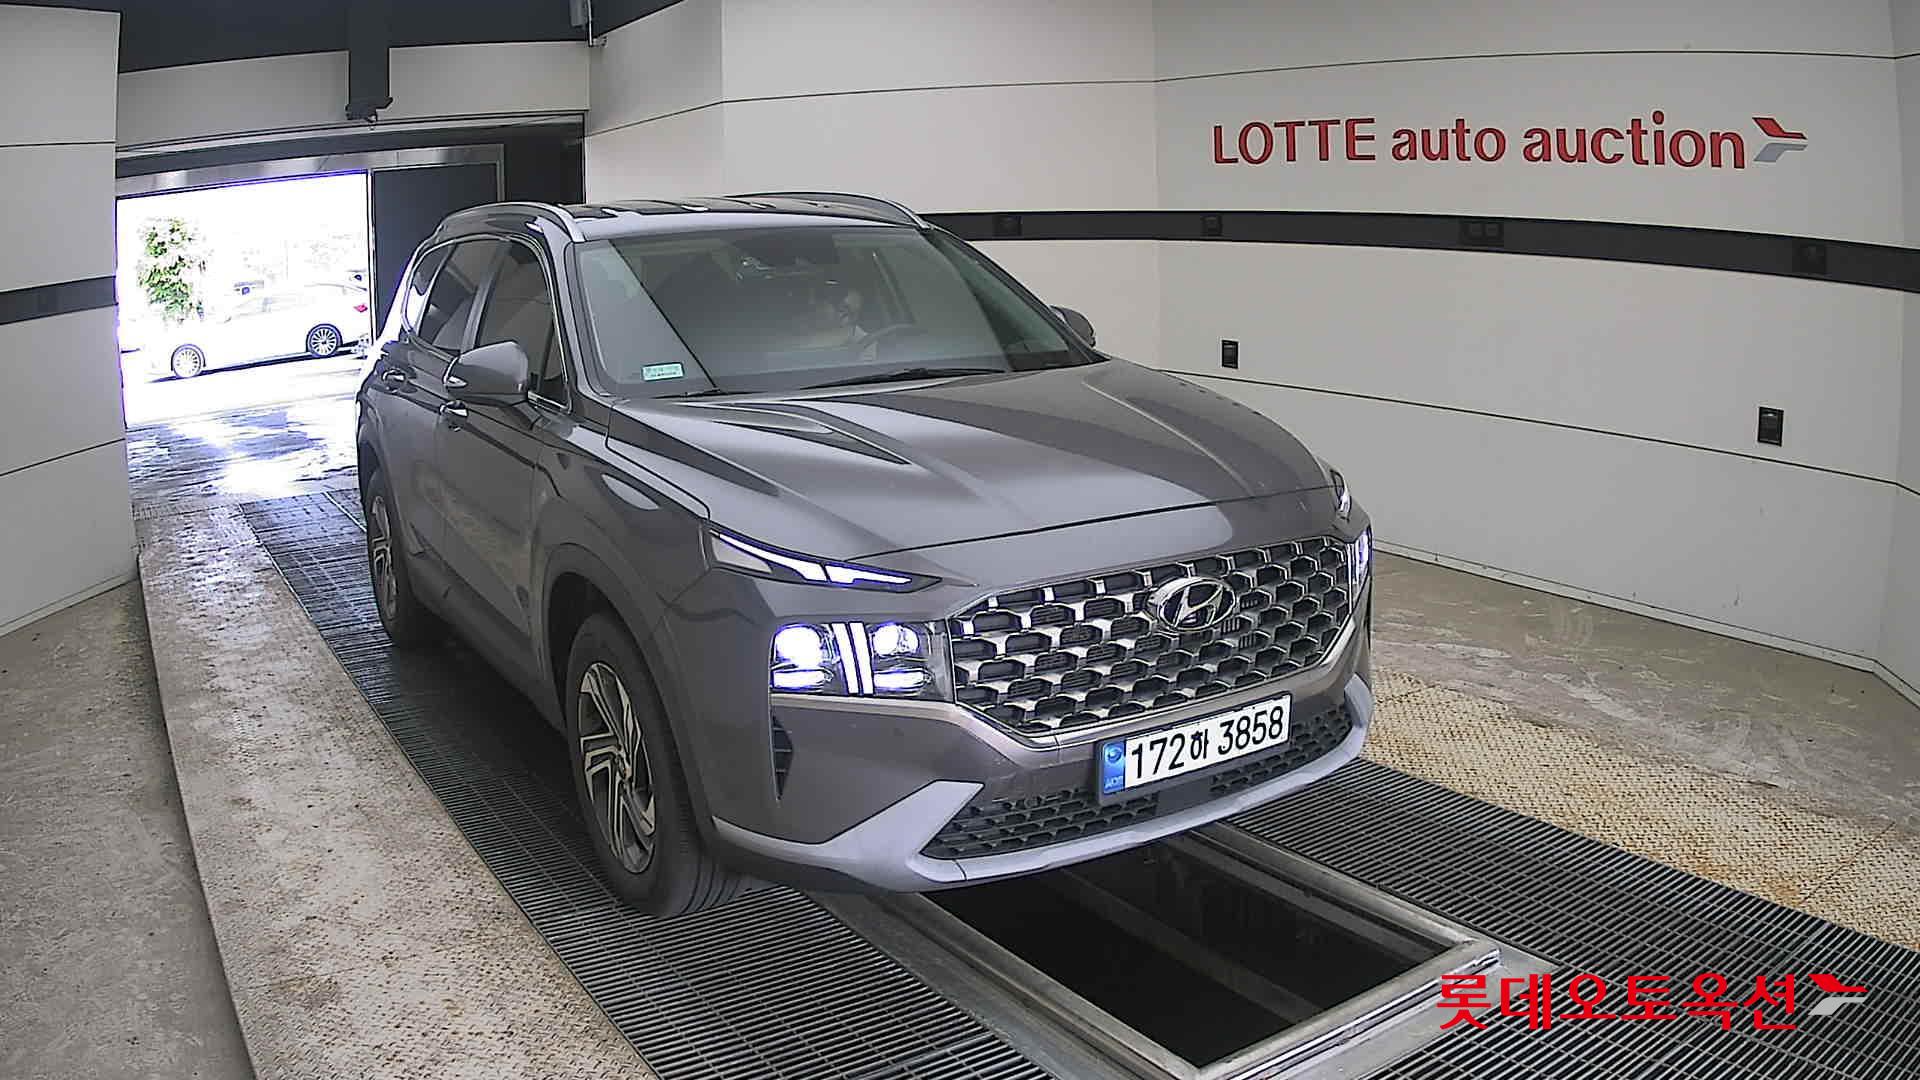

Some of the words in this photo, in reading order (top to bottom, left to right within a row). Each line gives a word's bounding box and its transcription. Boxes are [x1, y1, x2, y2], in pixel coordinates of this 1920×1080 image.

[1213, 117, 1377, 165] LOTTE
[1391, 118, 1507, 162] auto
[1522, 110, 1746, 169] auction
[1131, 729, 1209, 779] 172하
[1217, 705, 1284, 755] 3858
